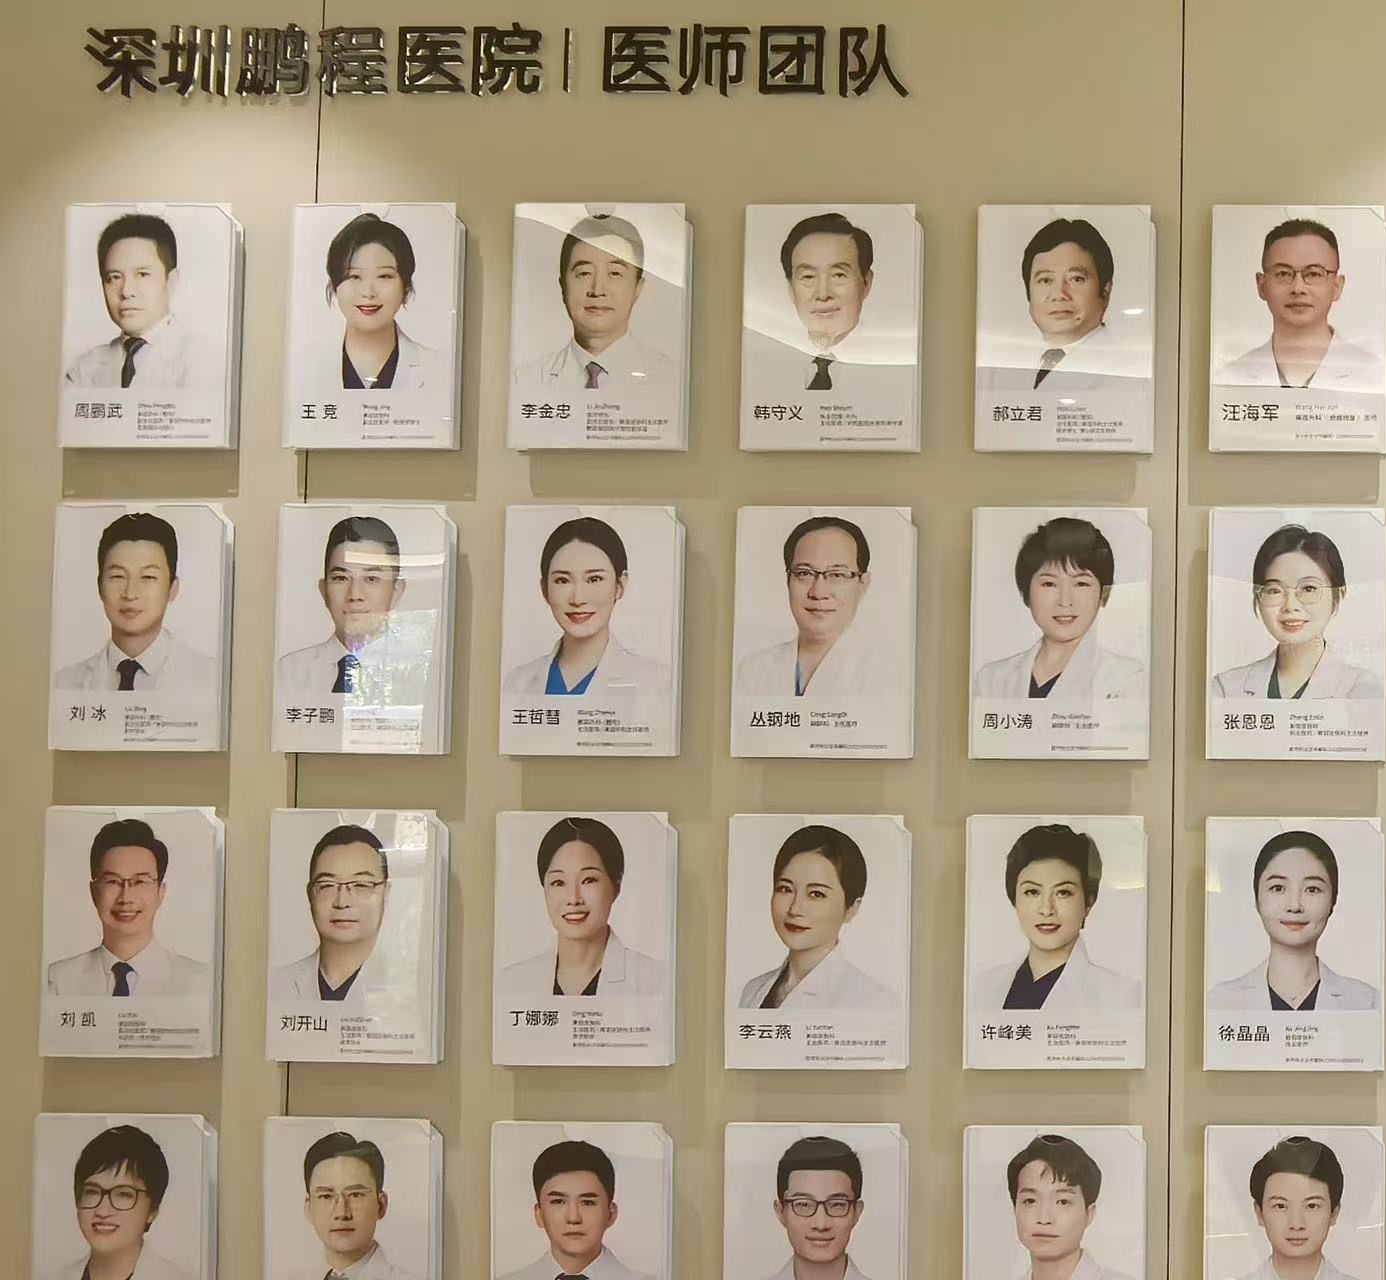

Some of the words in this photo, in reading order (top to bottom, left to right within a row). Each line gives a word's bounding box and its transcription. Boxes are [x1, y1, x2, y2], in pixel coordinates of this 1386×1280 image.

[84, 22, 544, 98] 深圳鹏程医院
[602, 23, 909, 98] 医师团队
[74, 402, 123, 419] 周鹏武
[521, 403, 571, 420] 李金忠
[753, 404, 804, 421] 韩守义
[992, 405, 1043, 422] 郝立君
[1221, 403, 1280, 422] 汪海军
[285, 707, 335, 724] 李子鹏
[982, 713, 1033, 730] 周小涛
[1223, 713, 1275, 731] 张恩恩
[280, 1015, 328, 1032] 刘开山
[739, 1024, 792, 1040] 李云燕
[980, 1024, 1032, 1041] 许峰美
[1218, 1024, 1270, 1043] 徐晶晶
